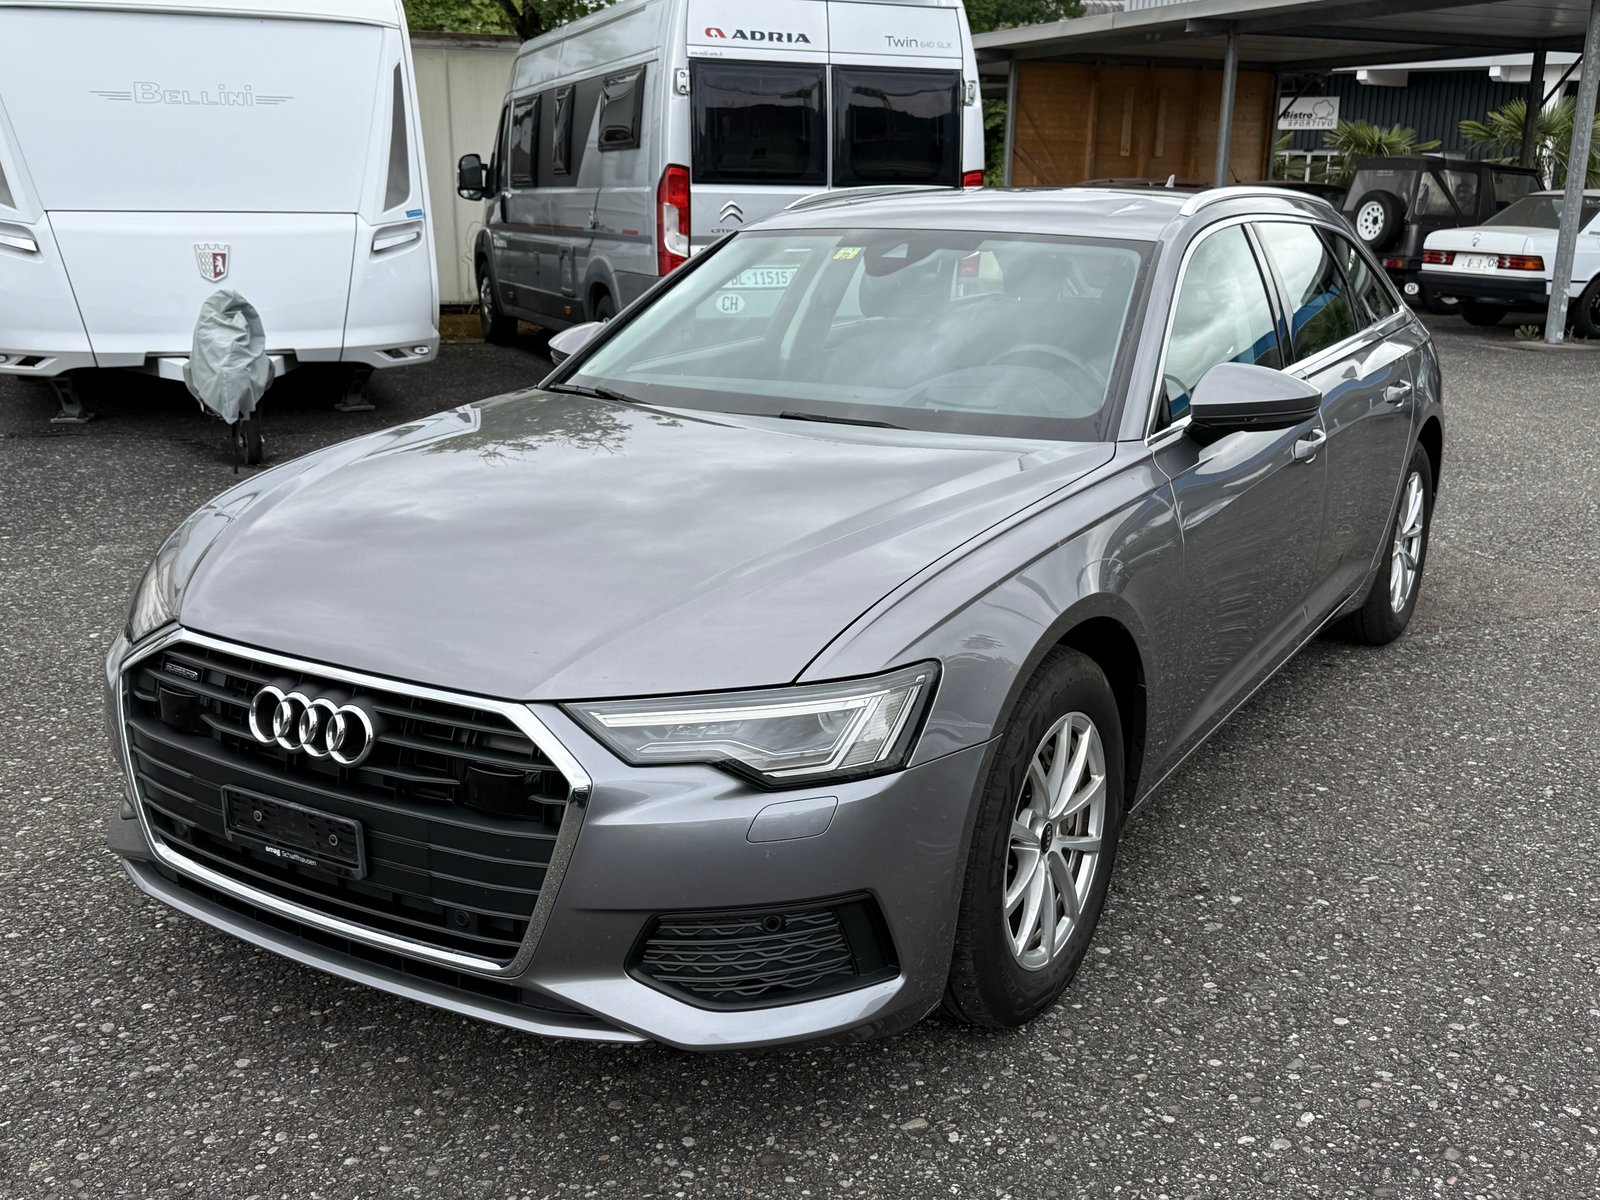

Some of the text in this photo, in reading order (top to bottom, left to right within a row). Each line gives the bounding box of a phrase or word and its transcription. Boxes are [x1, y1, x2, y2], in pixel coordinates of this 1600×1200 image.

[732, 29, 811, 44] ADRIA
[884, 35, 918, 48] Twin
[936, 41, 952, 49] SLX
[1287, 120, 1334, 128] SPORTIVO
[1407, 284, 1416, 293] CH
[721, 296, 739, 312] CH
